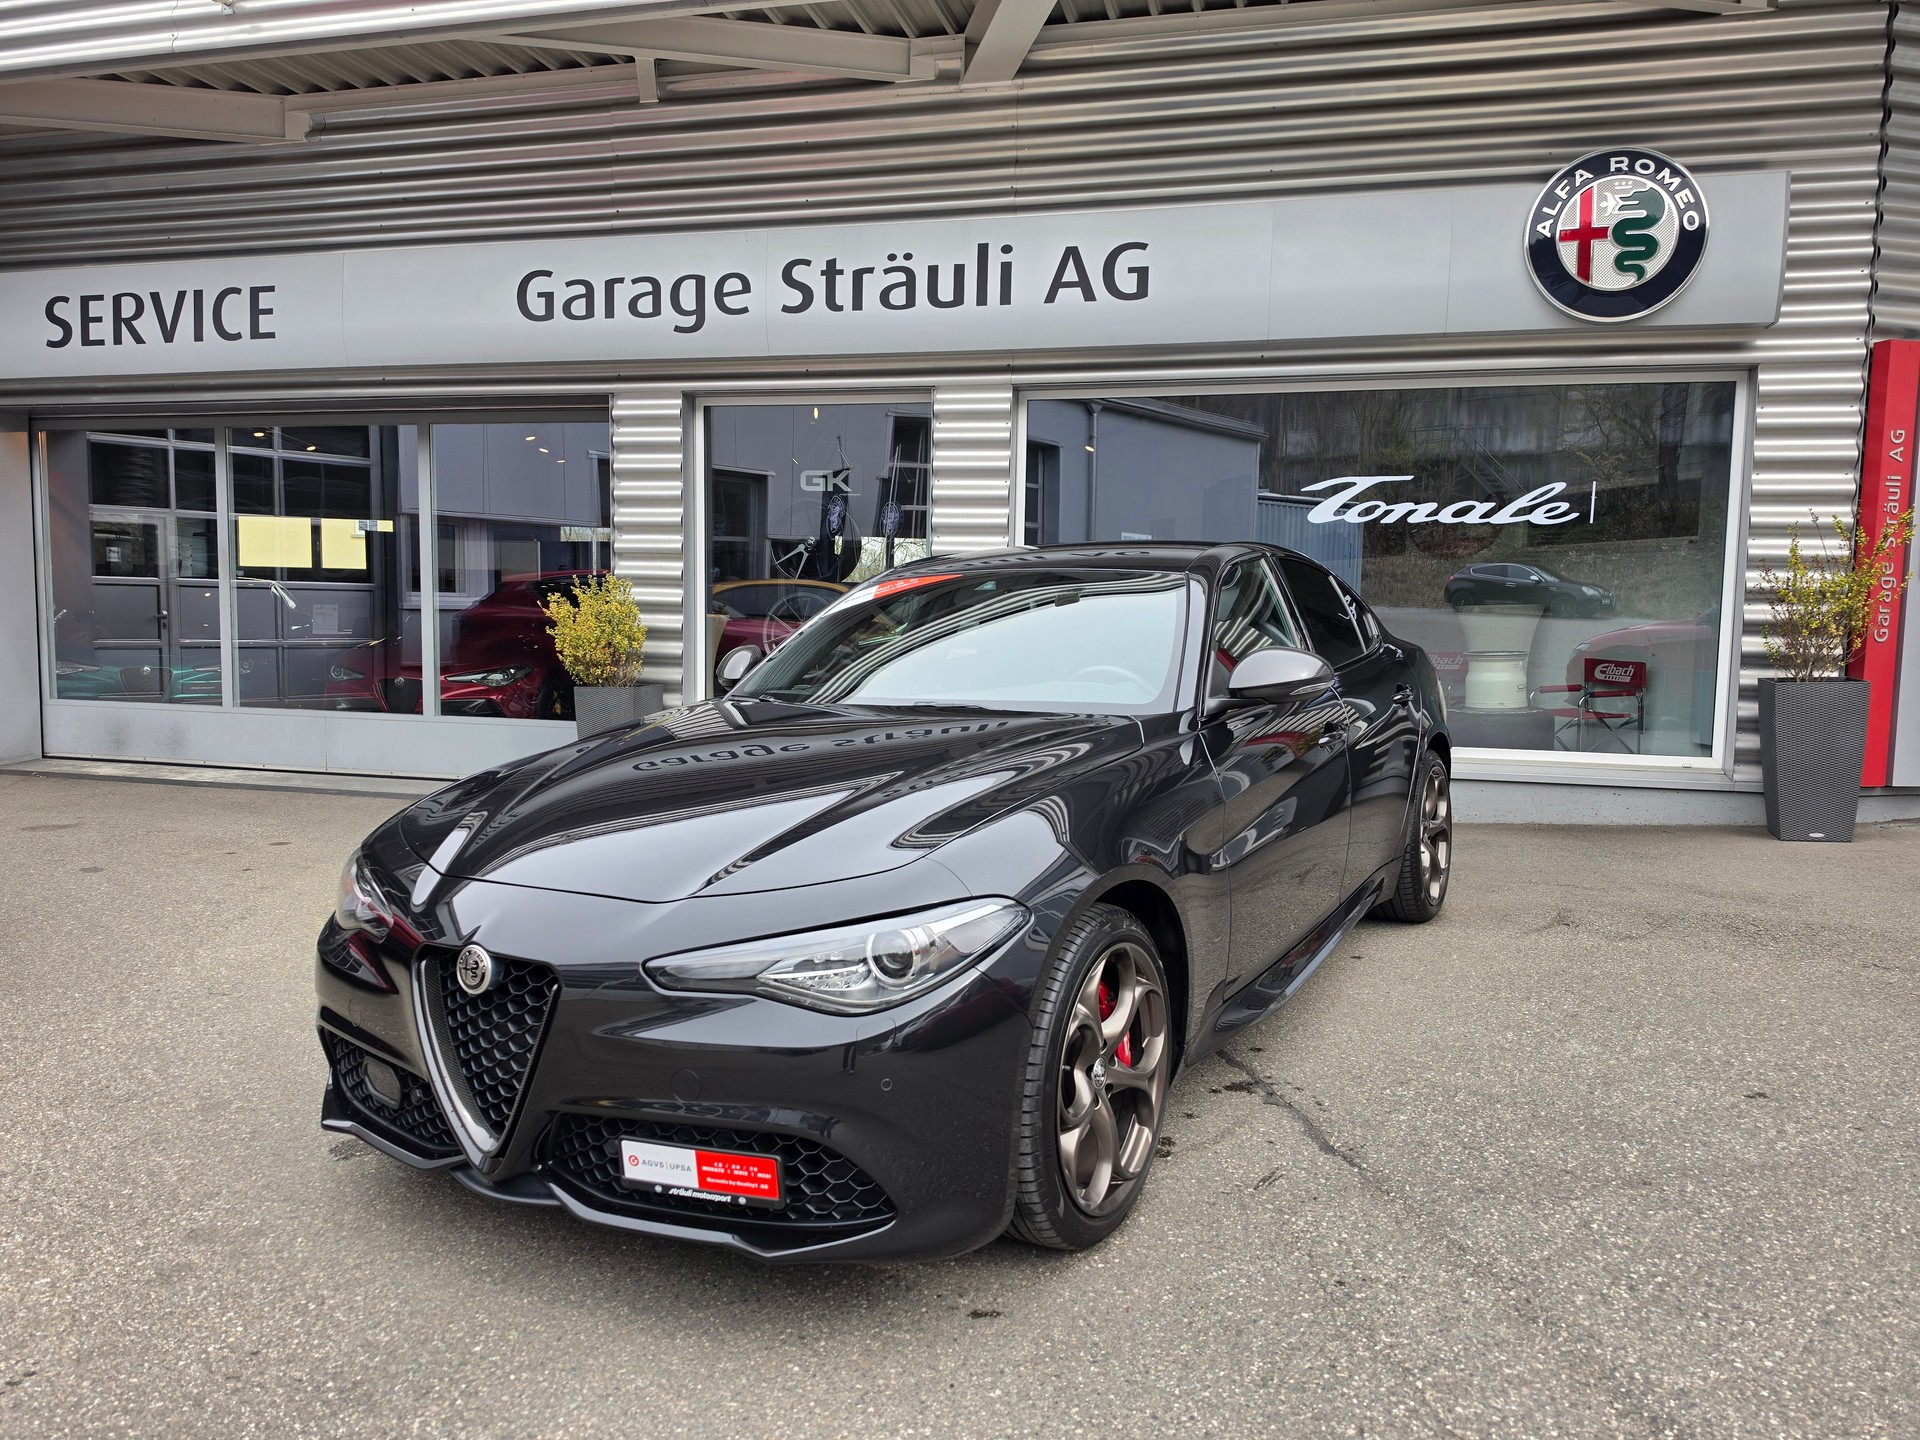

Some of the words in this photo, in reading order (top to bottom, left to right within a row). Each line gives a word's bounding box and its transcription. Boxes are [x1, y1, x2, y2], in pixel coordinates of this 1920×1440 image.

[1536, 168, 1594, 238] ALFA
[1610, 156, 1700, 231] ROMEO
[516, 269, 751, 334] Garage
[780, 242, 1013, 315] Sträuli
[1043, 241, 1150, 304] AG
[45, 285, 276, 349] SERVICE
[800, 469, 853, 492] GK
[1300, 475, 1580, 525] Tonale
[1874, 561, 1897, 643] Garage
[1889, 429, 1906, 462] AG
[1594, 663, 1635, 681] Eibach
[642, 1159, 665, 1168] AGVS
[669, 1163, 692, 1172] UPSA
[693, 1190, 731, 1202] motorsport
